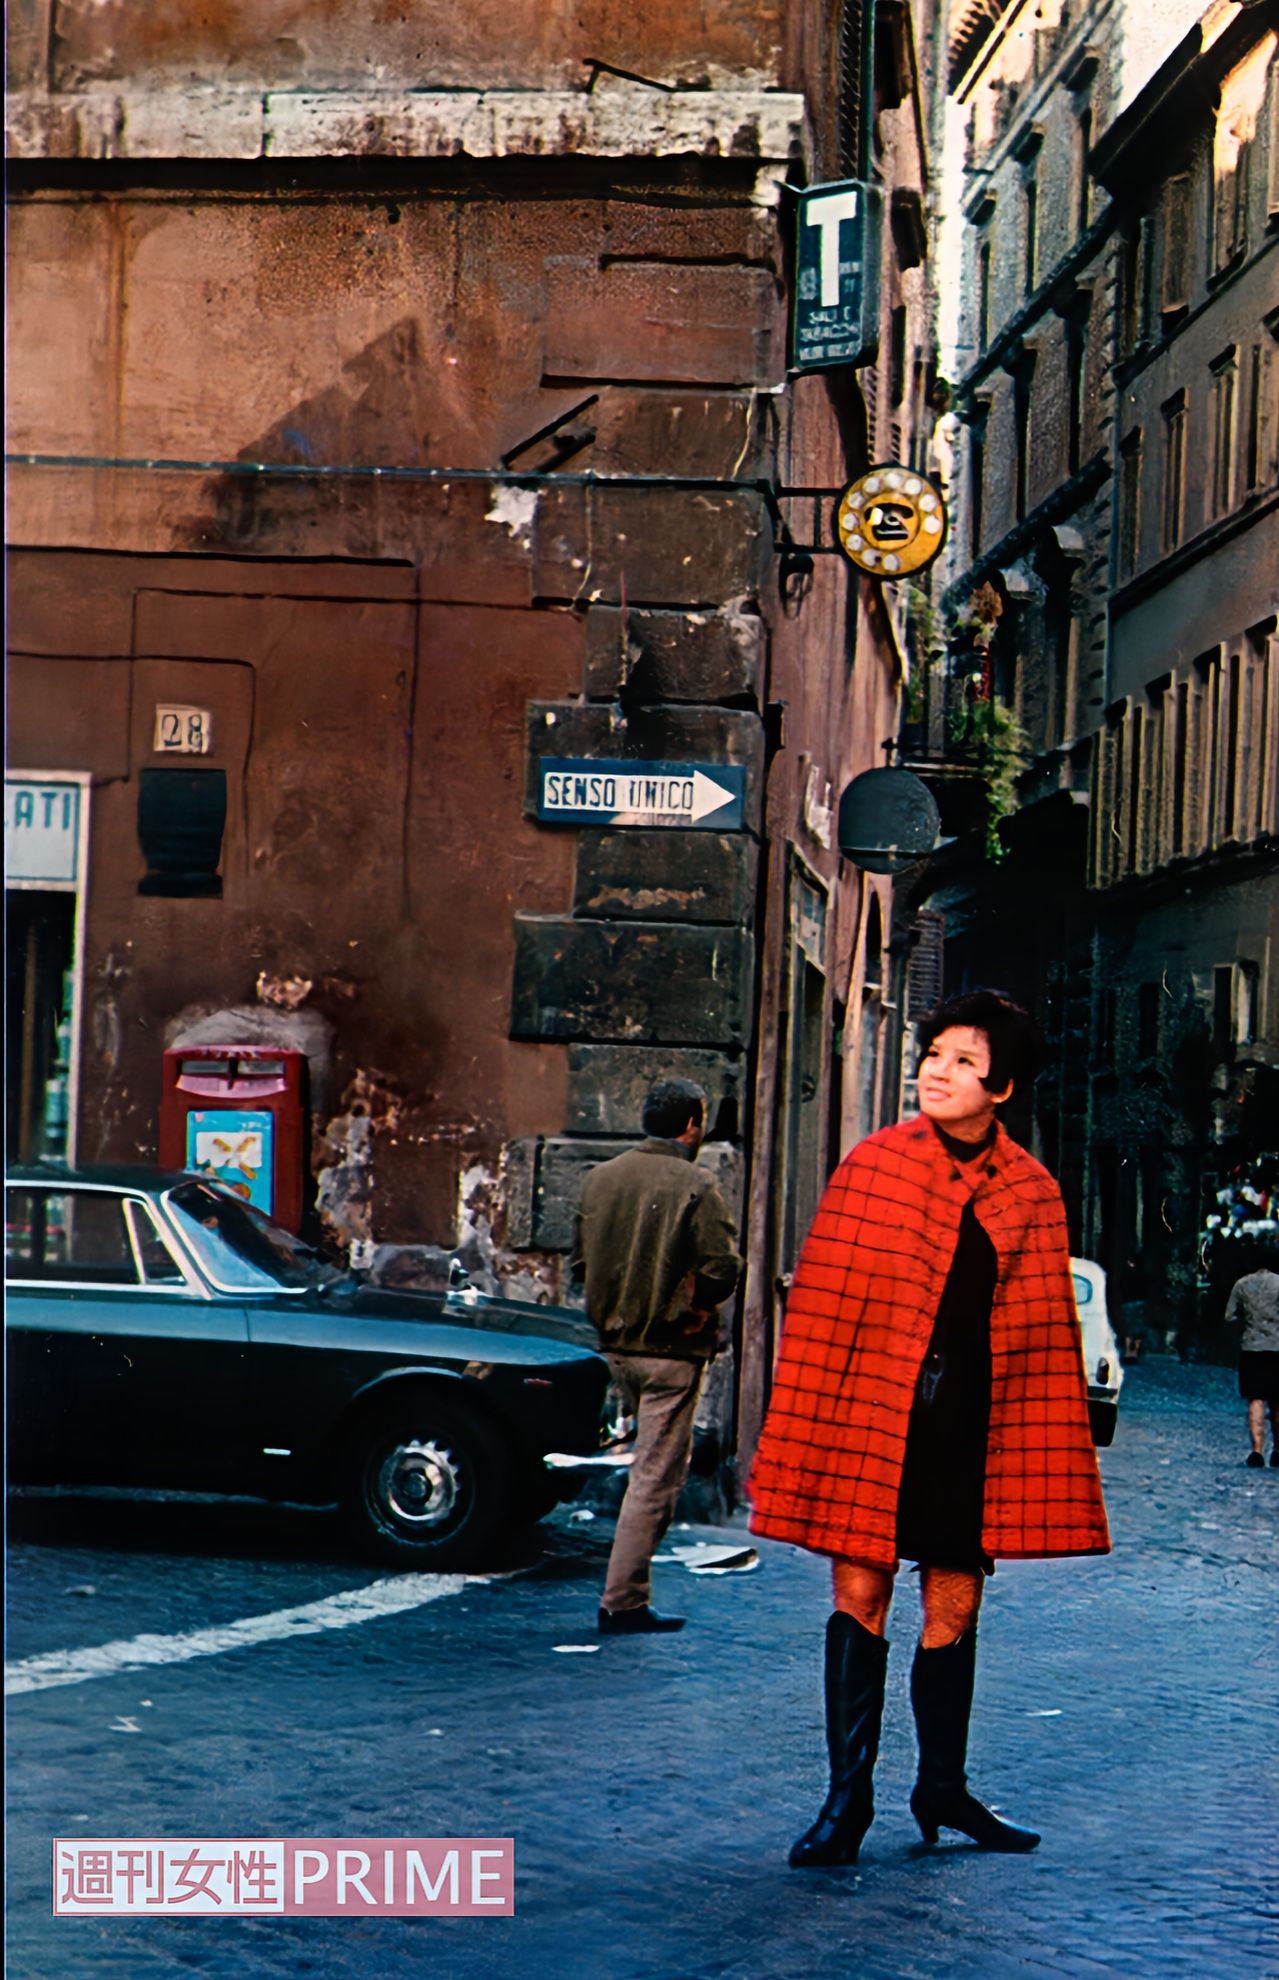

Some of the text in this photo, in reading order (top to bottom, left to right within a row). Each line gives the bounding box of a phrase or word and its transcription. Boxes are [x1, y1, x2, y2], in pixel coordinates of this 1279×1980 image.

[806, 191, 857, 307] T
[161, 713, 203, 748] 28
[5, 791, 71, 830] ATI
[547, 776, 693, 809] SENSO UNICO
